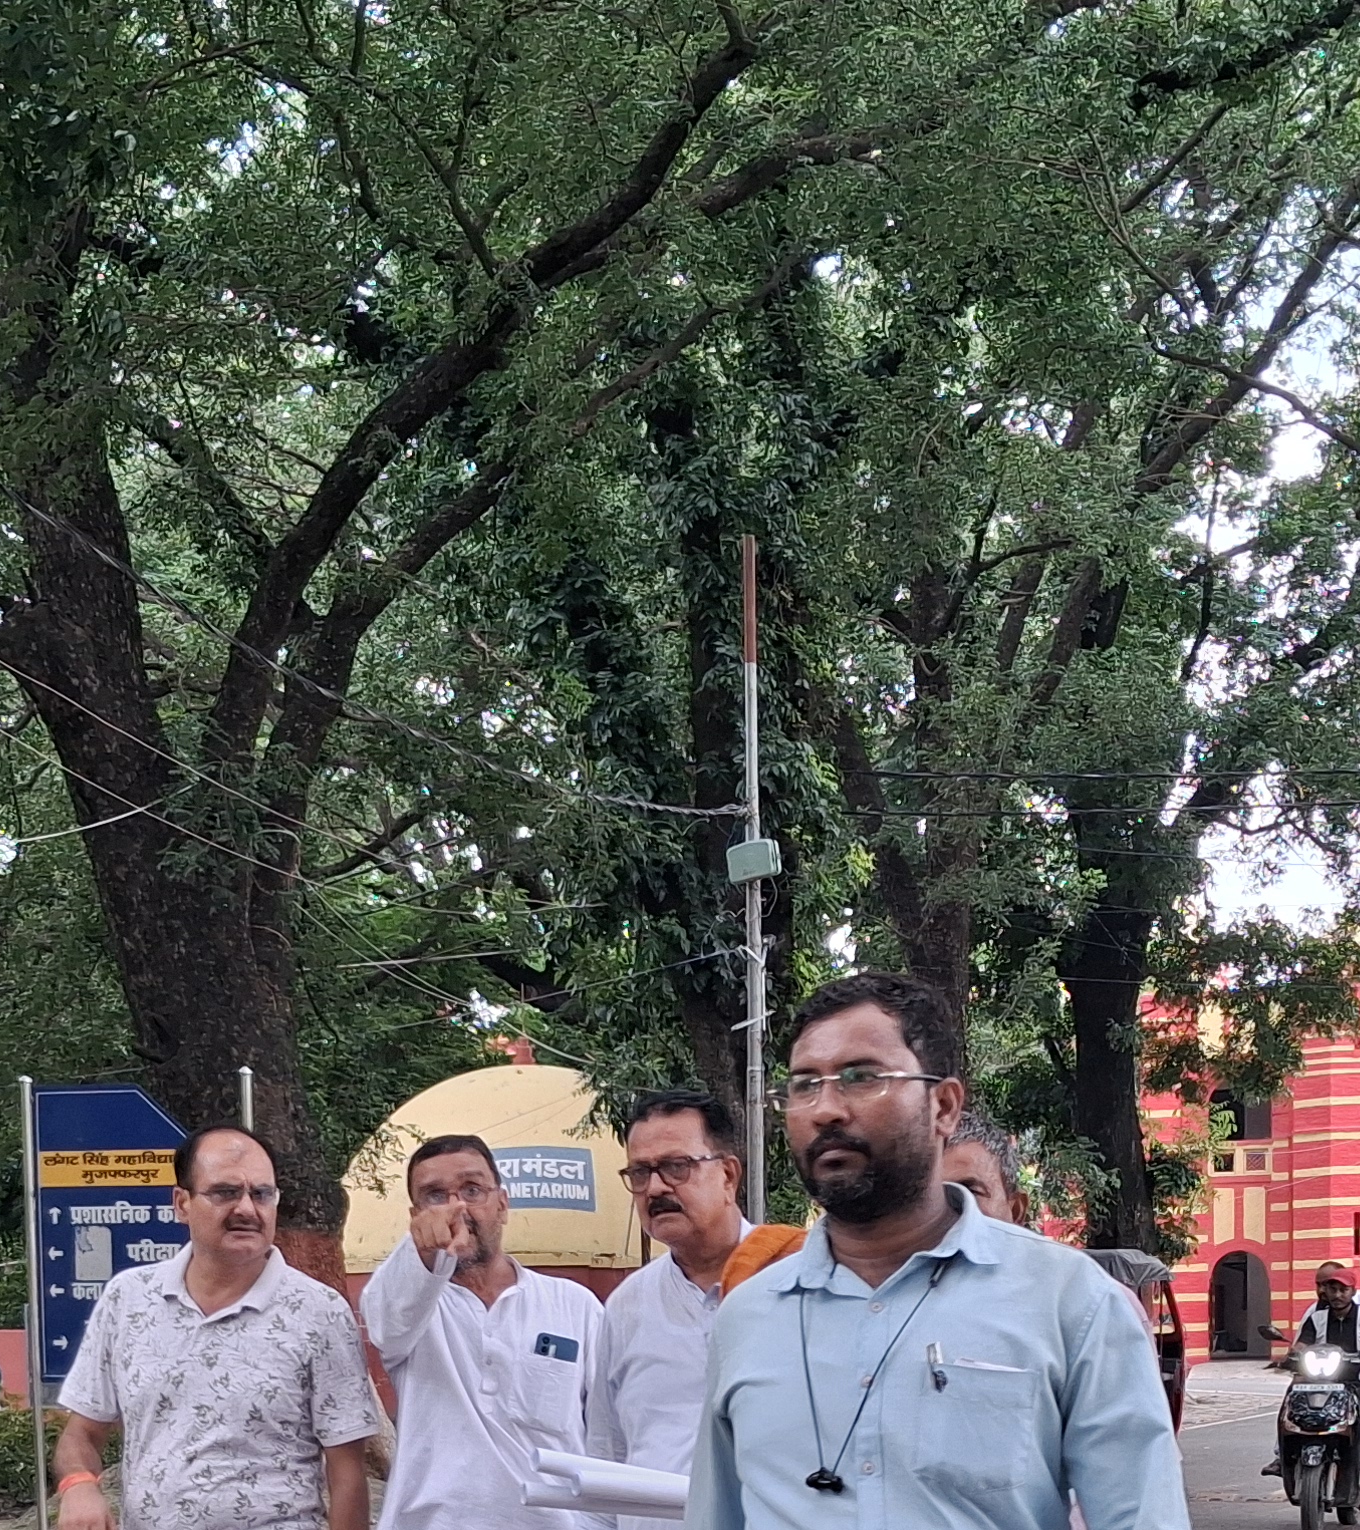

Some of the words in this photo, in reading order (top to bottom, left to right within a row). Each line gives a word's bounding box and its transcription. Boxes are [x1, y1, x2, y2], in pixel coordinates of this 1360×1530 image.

[82, 1151, 109, 1165] सिंह
[114, 1151, 175, 1165] महाविद्या
[496, 1153, 586, 1180] रामंडल
[501, 1182, 590, 1200] ANETARIUM
[69, 1200, 152, 1225] प्रशासनिक
